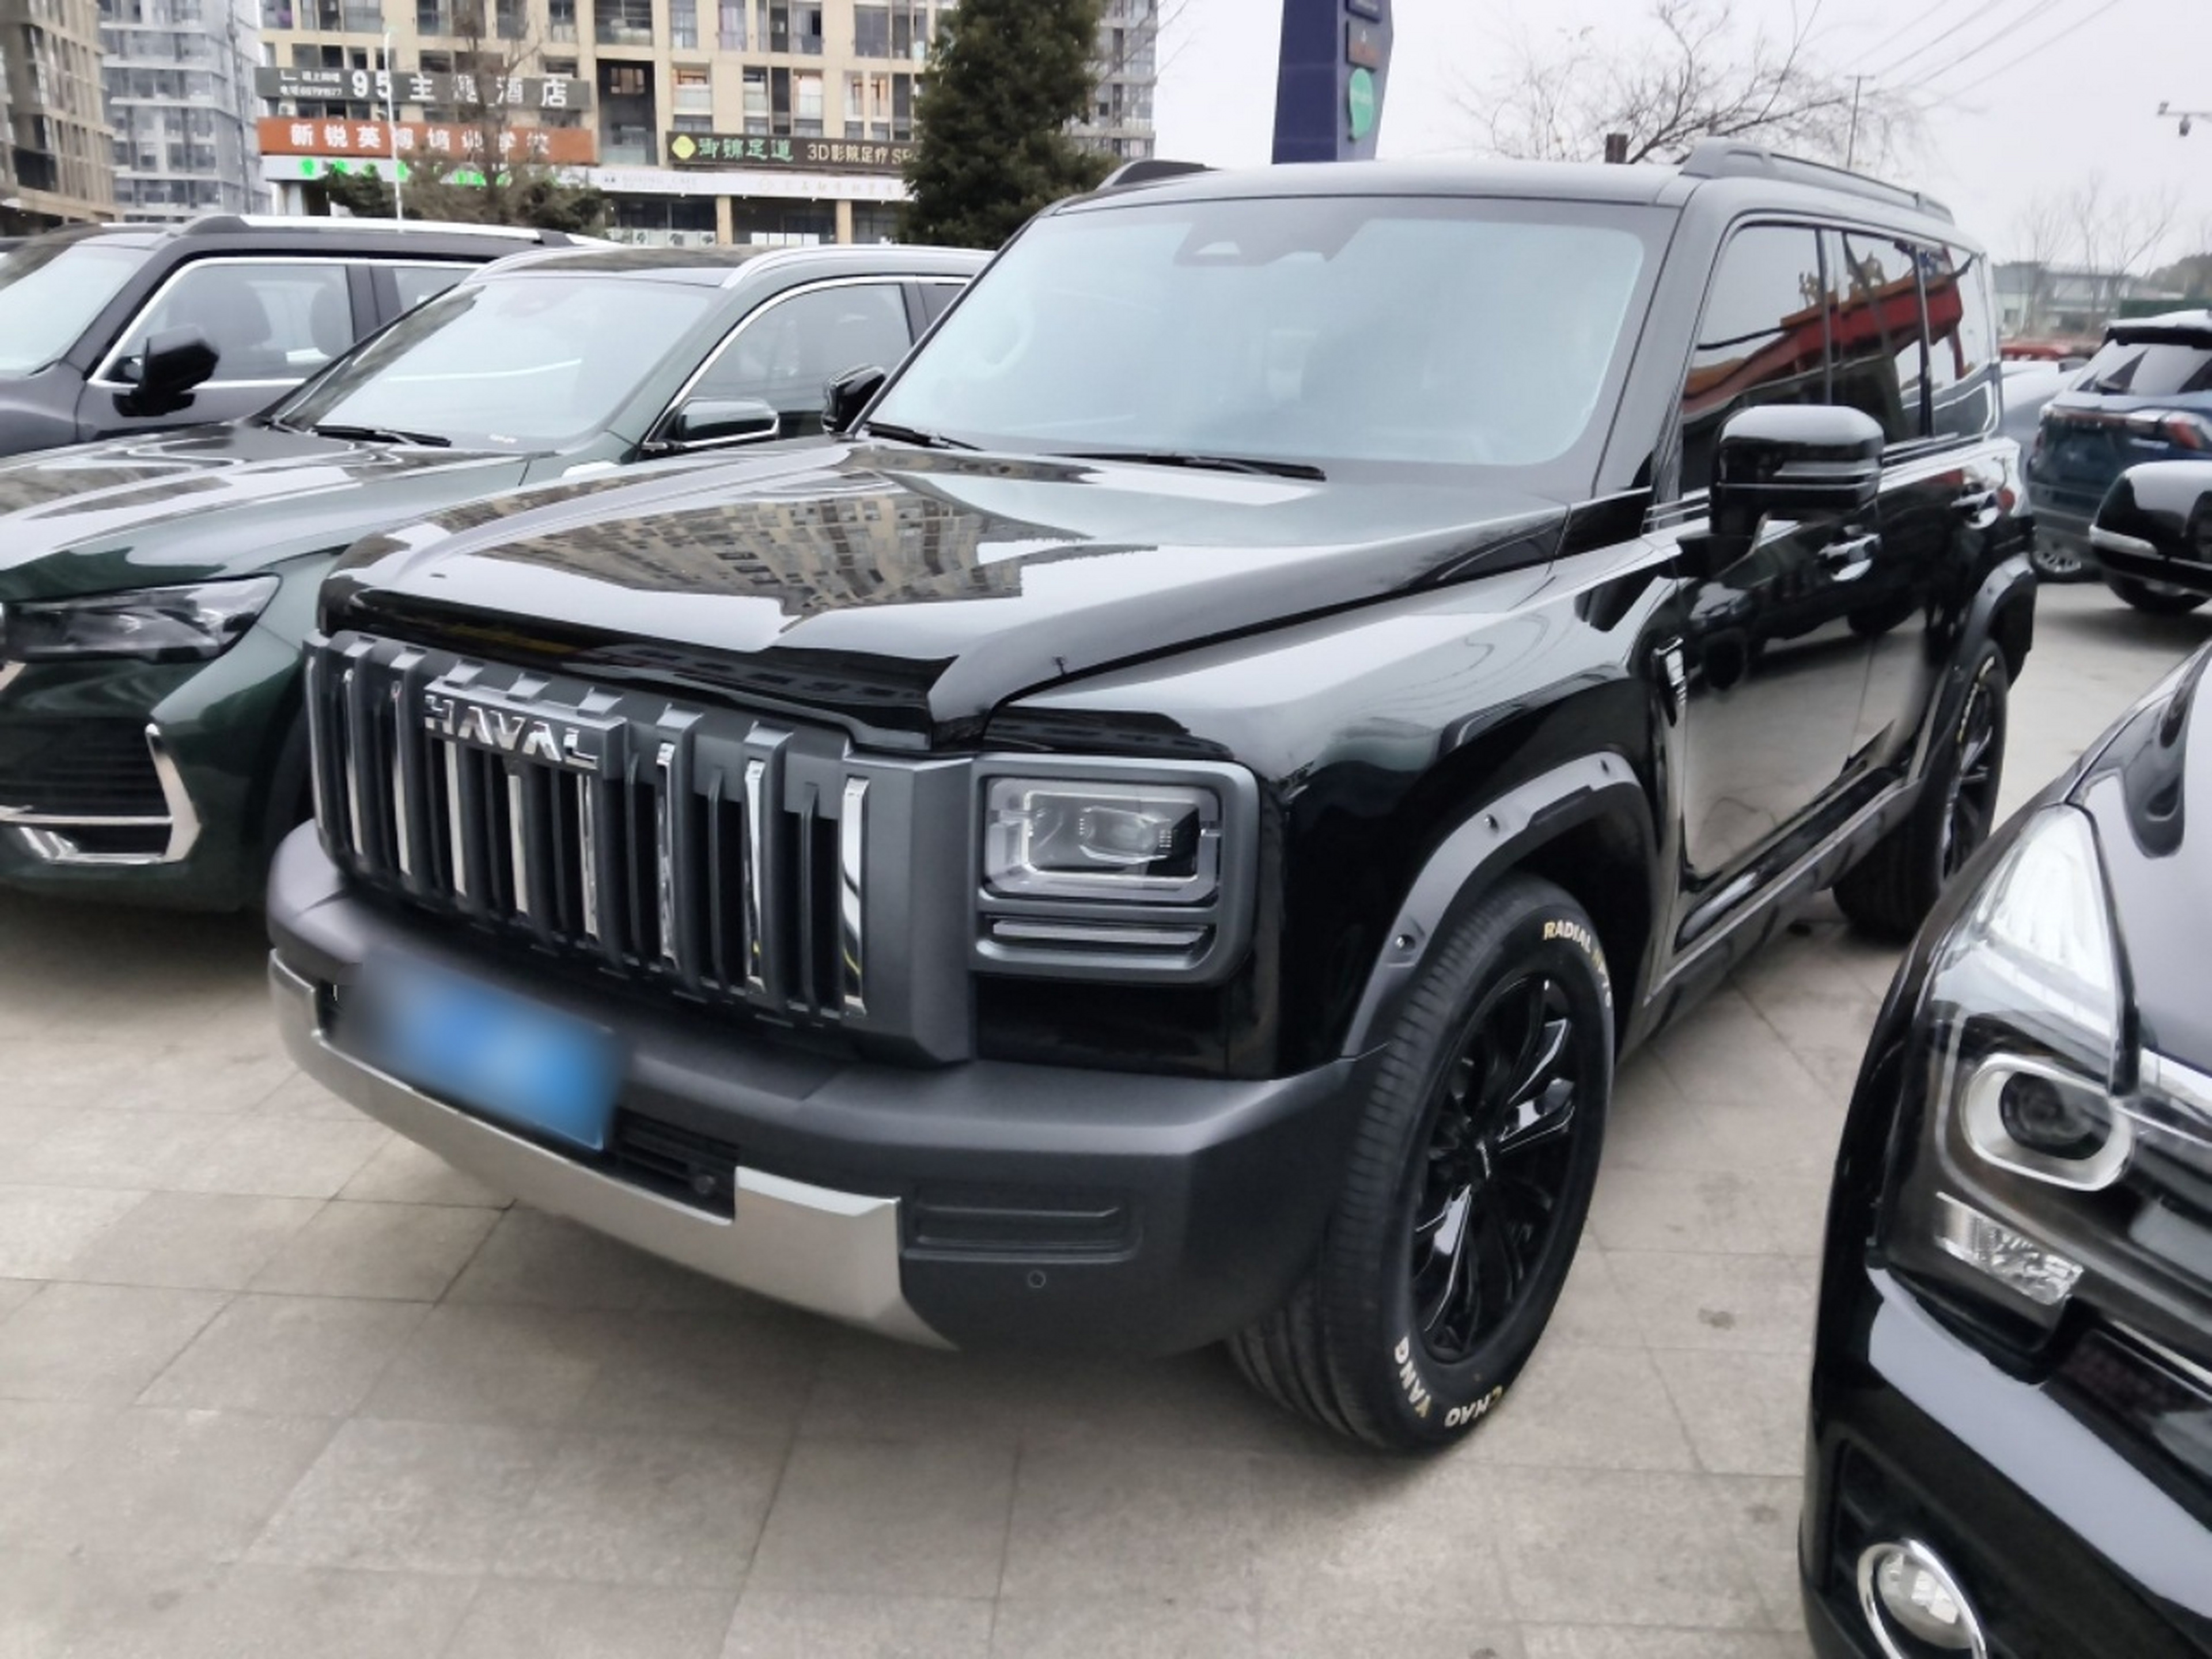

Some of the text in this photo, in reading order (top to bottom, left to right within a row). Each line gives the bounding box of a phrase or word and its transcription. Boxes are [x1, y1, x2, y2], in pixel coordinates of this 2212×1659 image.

[424, 694, 599, 770] HAVAL
[1543, 919, 1591, 954] RADIAL
[1395, 1336, 1503, 1427] CHAO YANG
